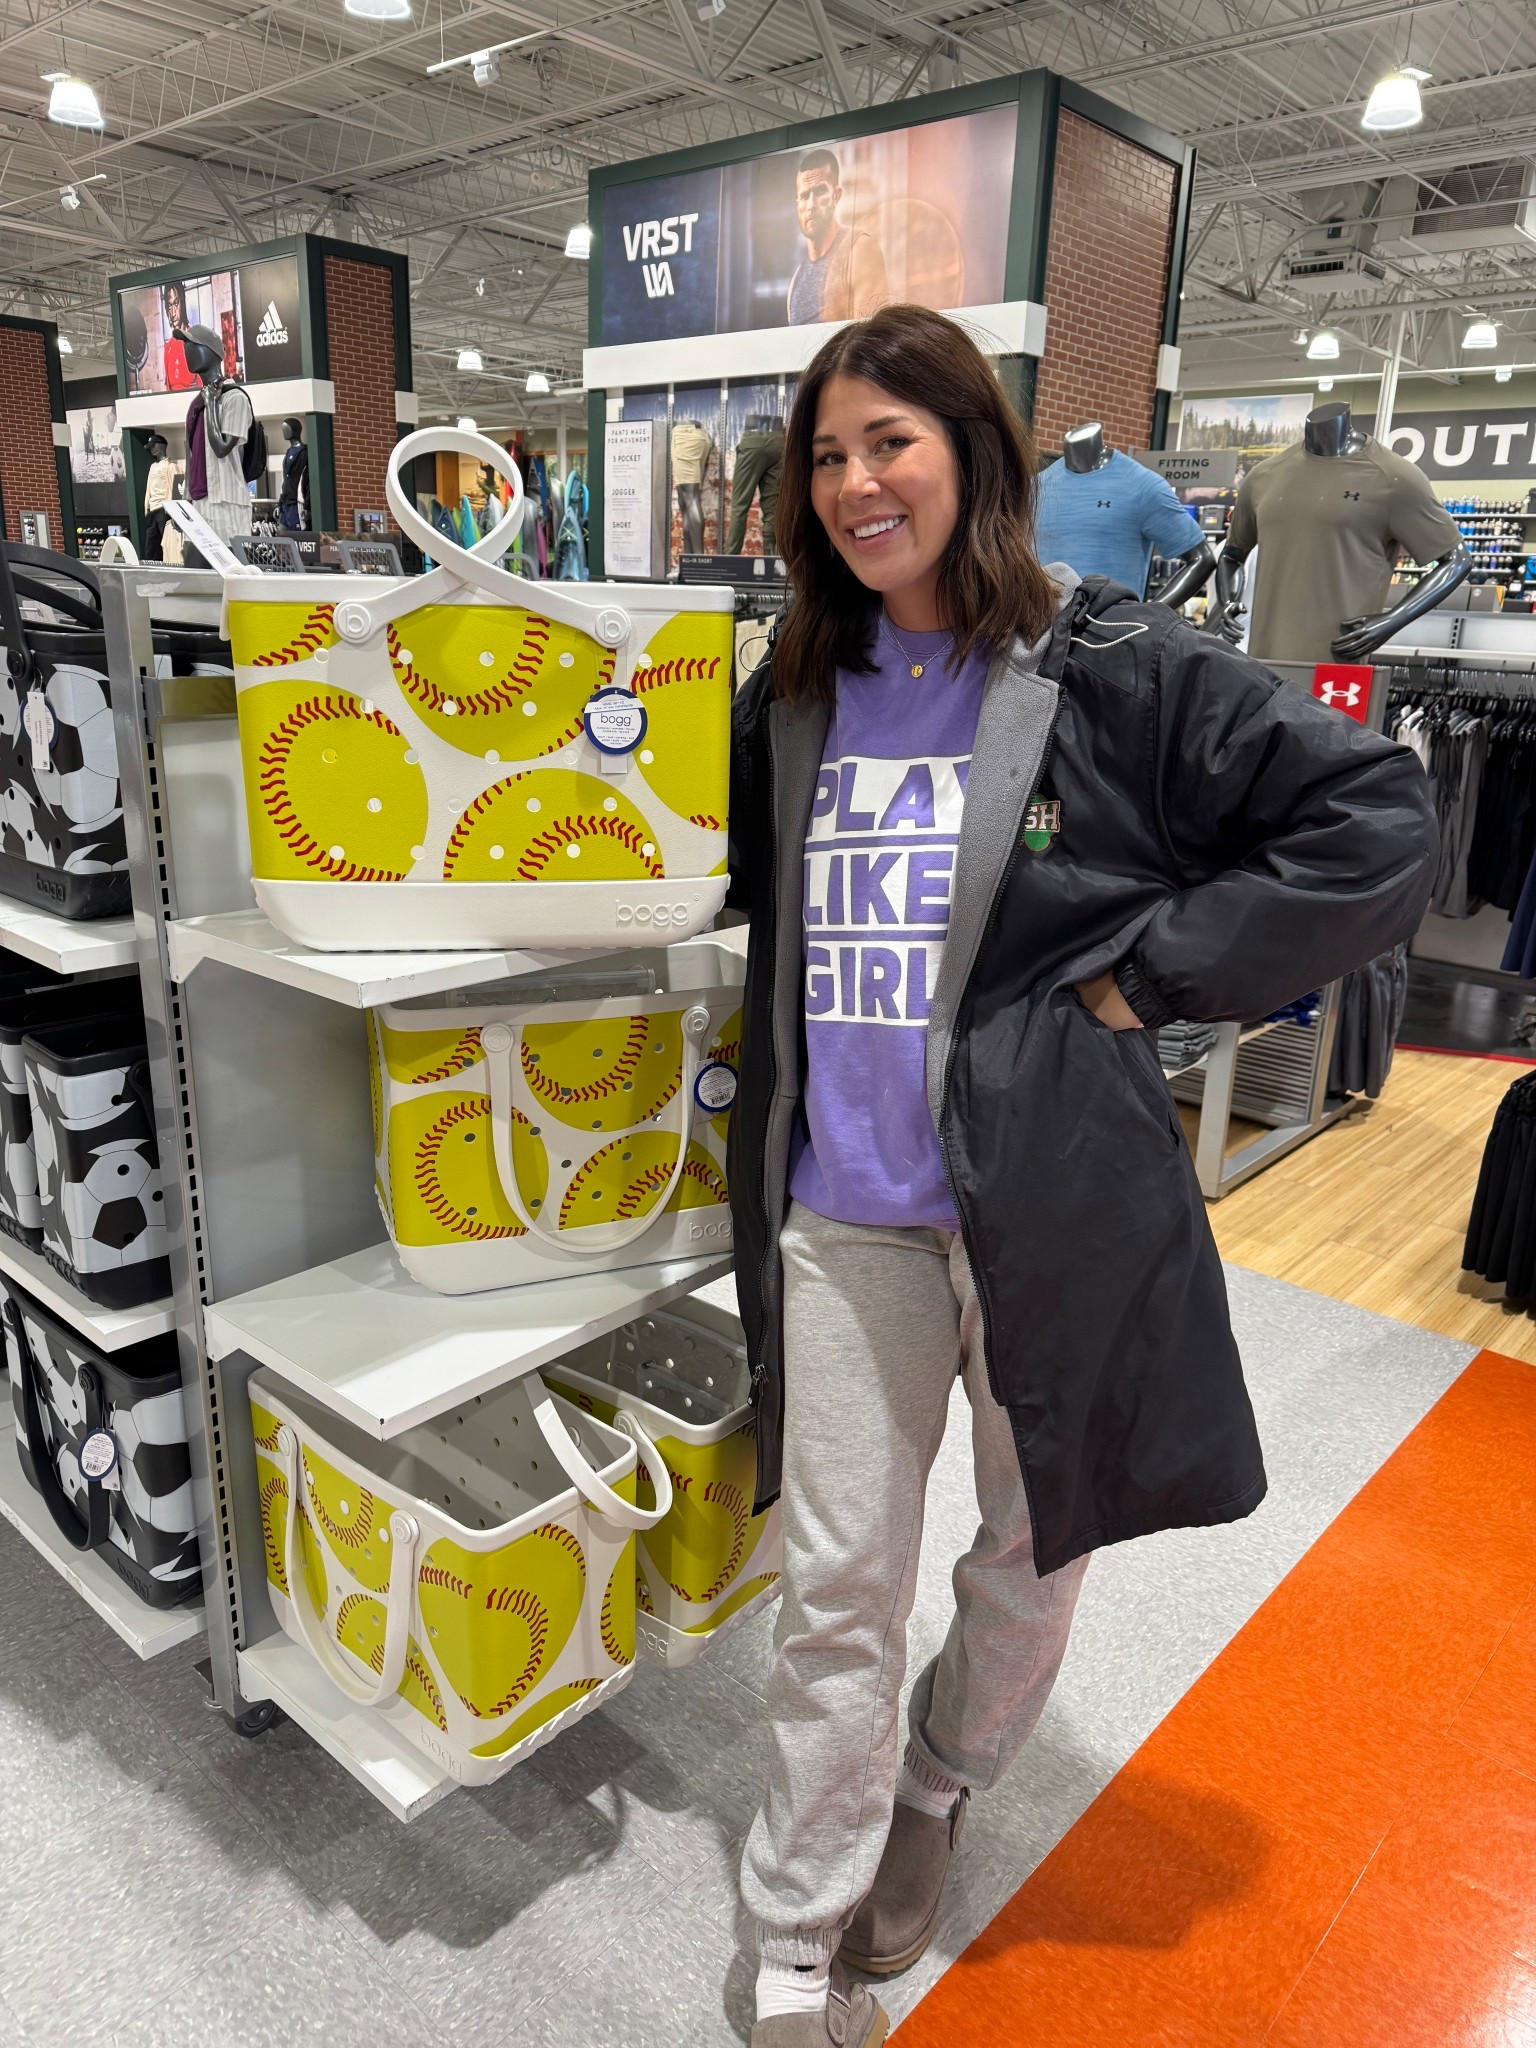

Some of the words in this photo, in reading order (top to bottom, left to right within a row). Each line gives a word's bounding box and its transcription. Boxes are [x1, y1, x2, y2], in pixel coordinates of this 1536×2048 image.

[623, 213, 698, 261] VRST
[256, 329, 288, 347] adidas
[1389, 421, 1536, 467] OUT
[618, 454, 641, 462] POCKET
[1158, 458, 1210, 468] FITTING
[1165, 471, 1200, 480] ROOM
[611, 488, 636, 496] JOGGER
[612, 521, 632, 529] SHORT
[299, 541, 316, 553] VRST
[600, 712, 632, 727] bogg
[36, 872, 66, 904] bogg
[802, 851, 954, 926] LIKE
[615, 899, 691, 927] bogg
[805, 945, 933, 1020] GIRL
[689, 1221, 732, 1240] bog
[636, 1626, 669, 1658] ogg
